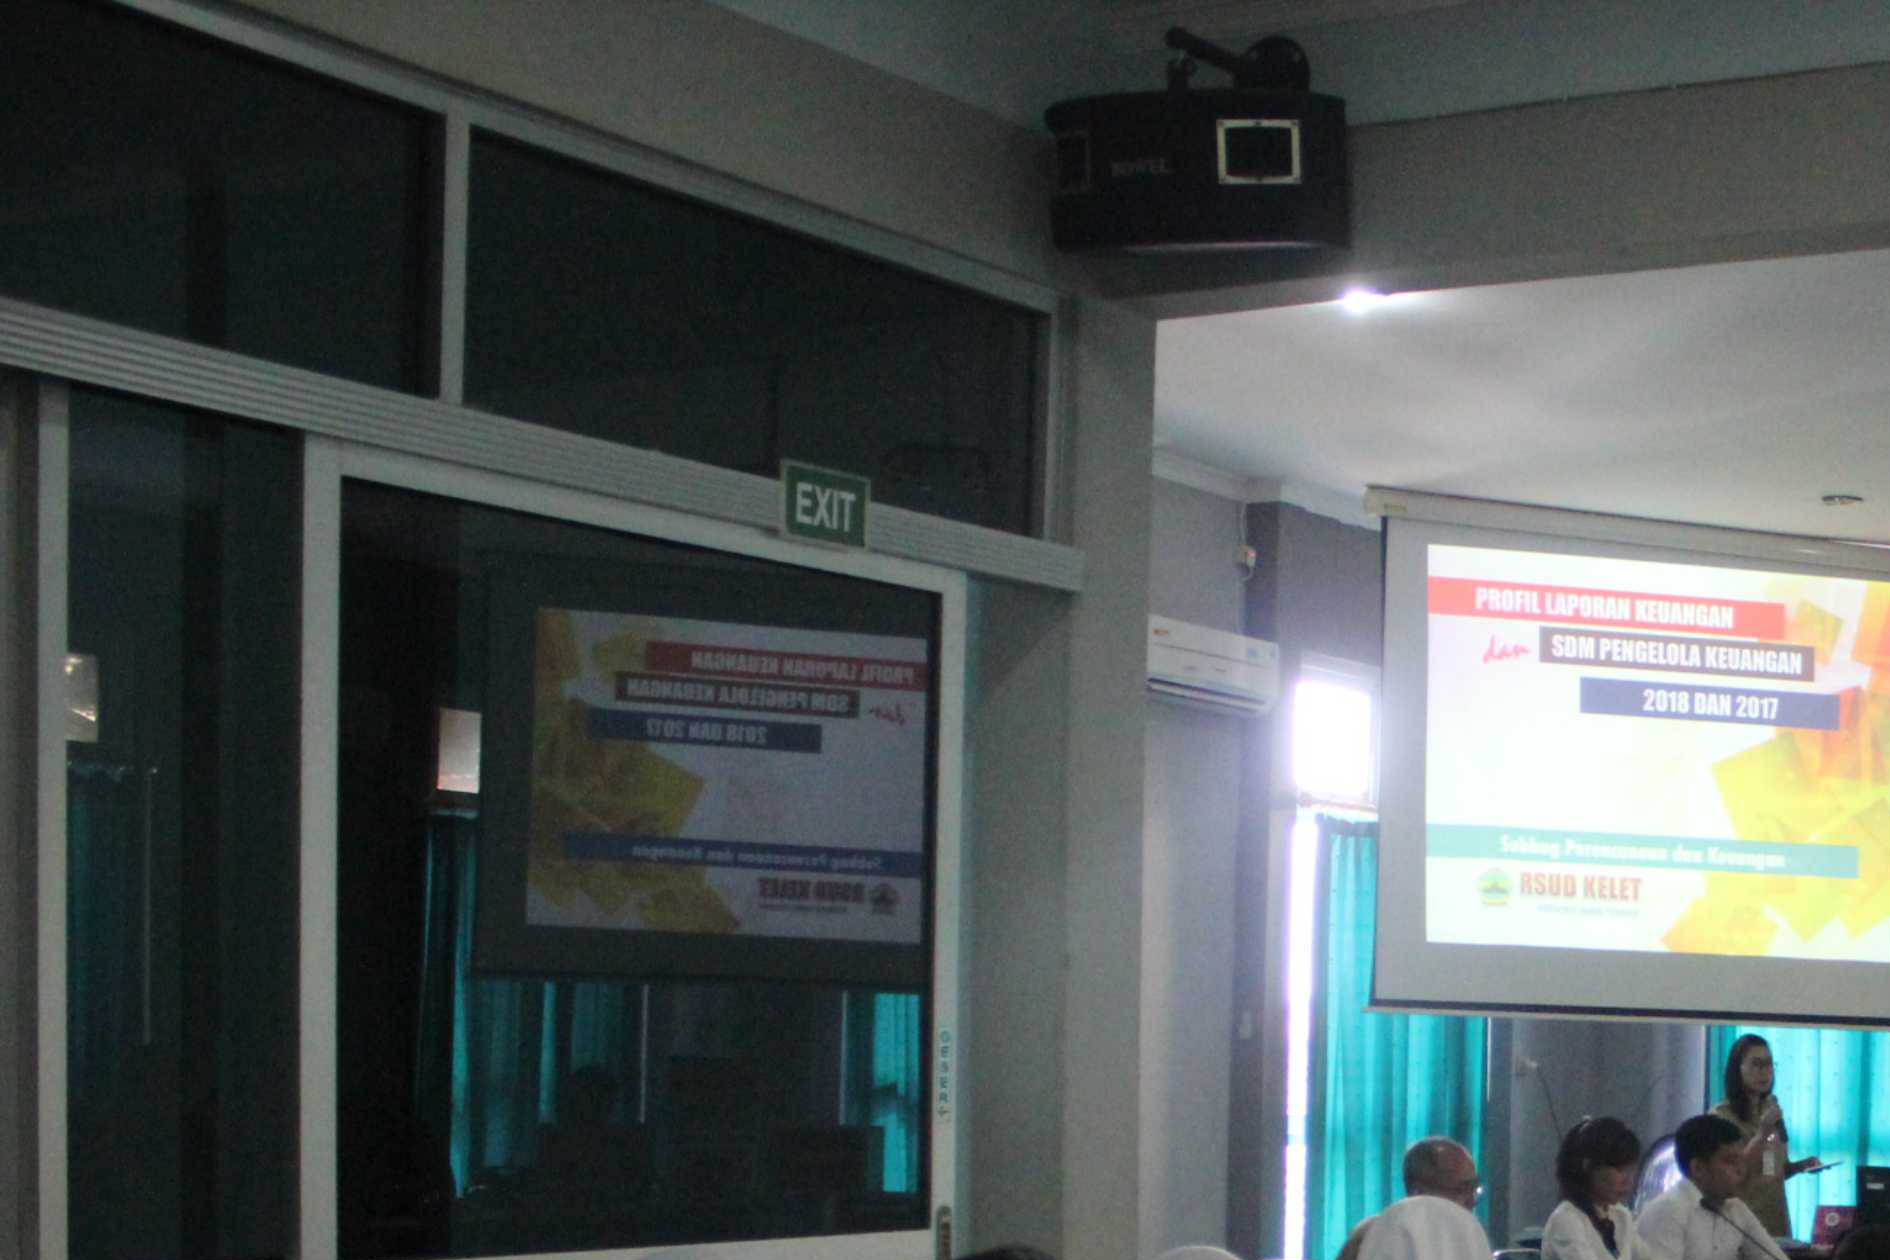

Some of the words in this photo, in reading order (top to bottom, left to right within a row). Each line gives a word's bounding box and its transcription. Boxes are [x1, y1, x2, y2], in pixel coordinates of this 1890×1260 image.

[796, 481, 856, 532] EXIT
[1475, 586, 1542, 614] PROFIL
[1545, 593, 1631, 621] LAPORAN
[1635, 600, 1734, 629] KEUANGAN
[1551, 633, 1595, 660] SDM
[1599, 638, 1701, 668] PENGELOLA
[1705, 645, 1803, 675] KEUANGAN
[1642, 688, 1691, 714] 2018
[1693, 693, 1732, 718] DAN
[1735, 695, 1780, 720] 2017
[1519, 872, 1577, 897] RSUD
[1583, 876, 1642, 902] KELET
